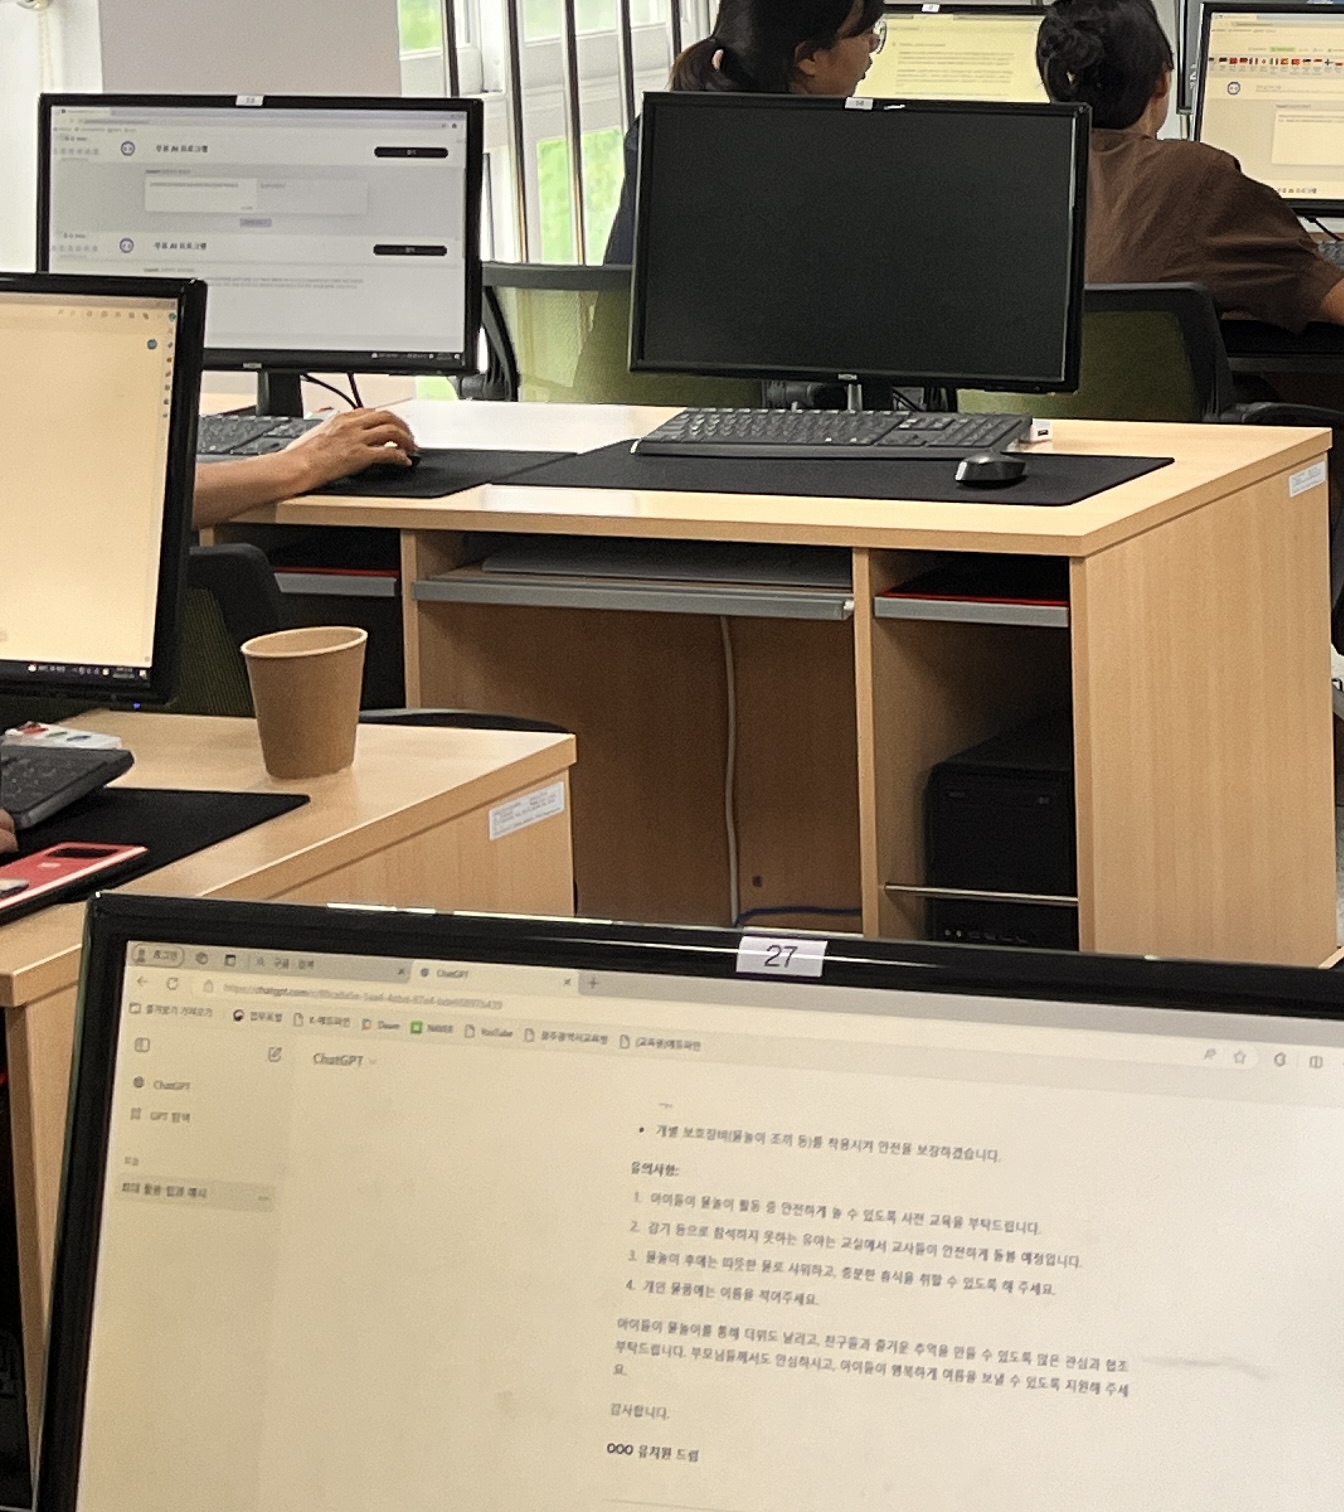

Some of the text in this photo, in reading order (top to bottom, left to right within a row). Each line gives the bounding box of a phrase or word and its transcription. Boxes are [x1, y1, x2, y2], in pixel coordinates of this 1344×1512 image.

[763, 944, 798, 969] 27
[313, 1052, 364, 1067] ChatGPT
[655, 1125, 912, 1156] 개별 안전을
[631, 1161, 680, 1177] 유의사항:
[651, 1192, 1041, 1236] 아이들이 물놀이 활동 안전하게 수 있도록 사전 교육을 부탁드립니다.
[648, 1221, 1082, 1269] 감기 못하는 교실에서 교사들이 안전하게 예정입니다.
[646, 1250, 1057, 1297] 물놀이 후에는 따뜻한 휴식을 수 있도록 주세요.
[643, 1280, 819, 1305] 개인 이름을 적어주세요.
[617, 1317, 1100, 1372] 아이들이 물놀이를 더위도 친구들과 즐거운 추억을 수 있도록 관심과
[615, 1340, 1101, 1396] 부탁드립니다. 부모님들께서도 안심하시고, 행복하게 여름을 수 있도록 지원해
[610, 1402, 670, 1421] 감사합니다.
[638, 1445, 699, 1463] 유치원 드림
